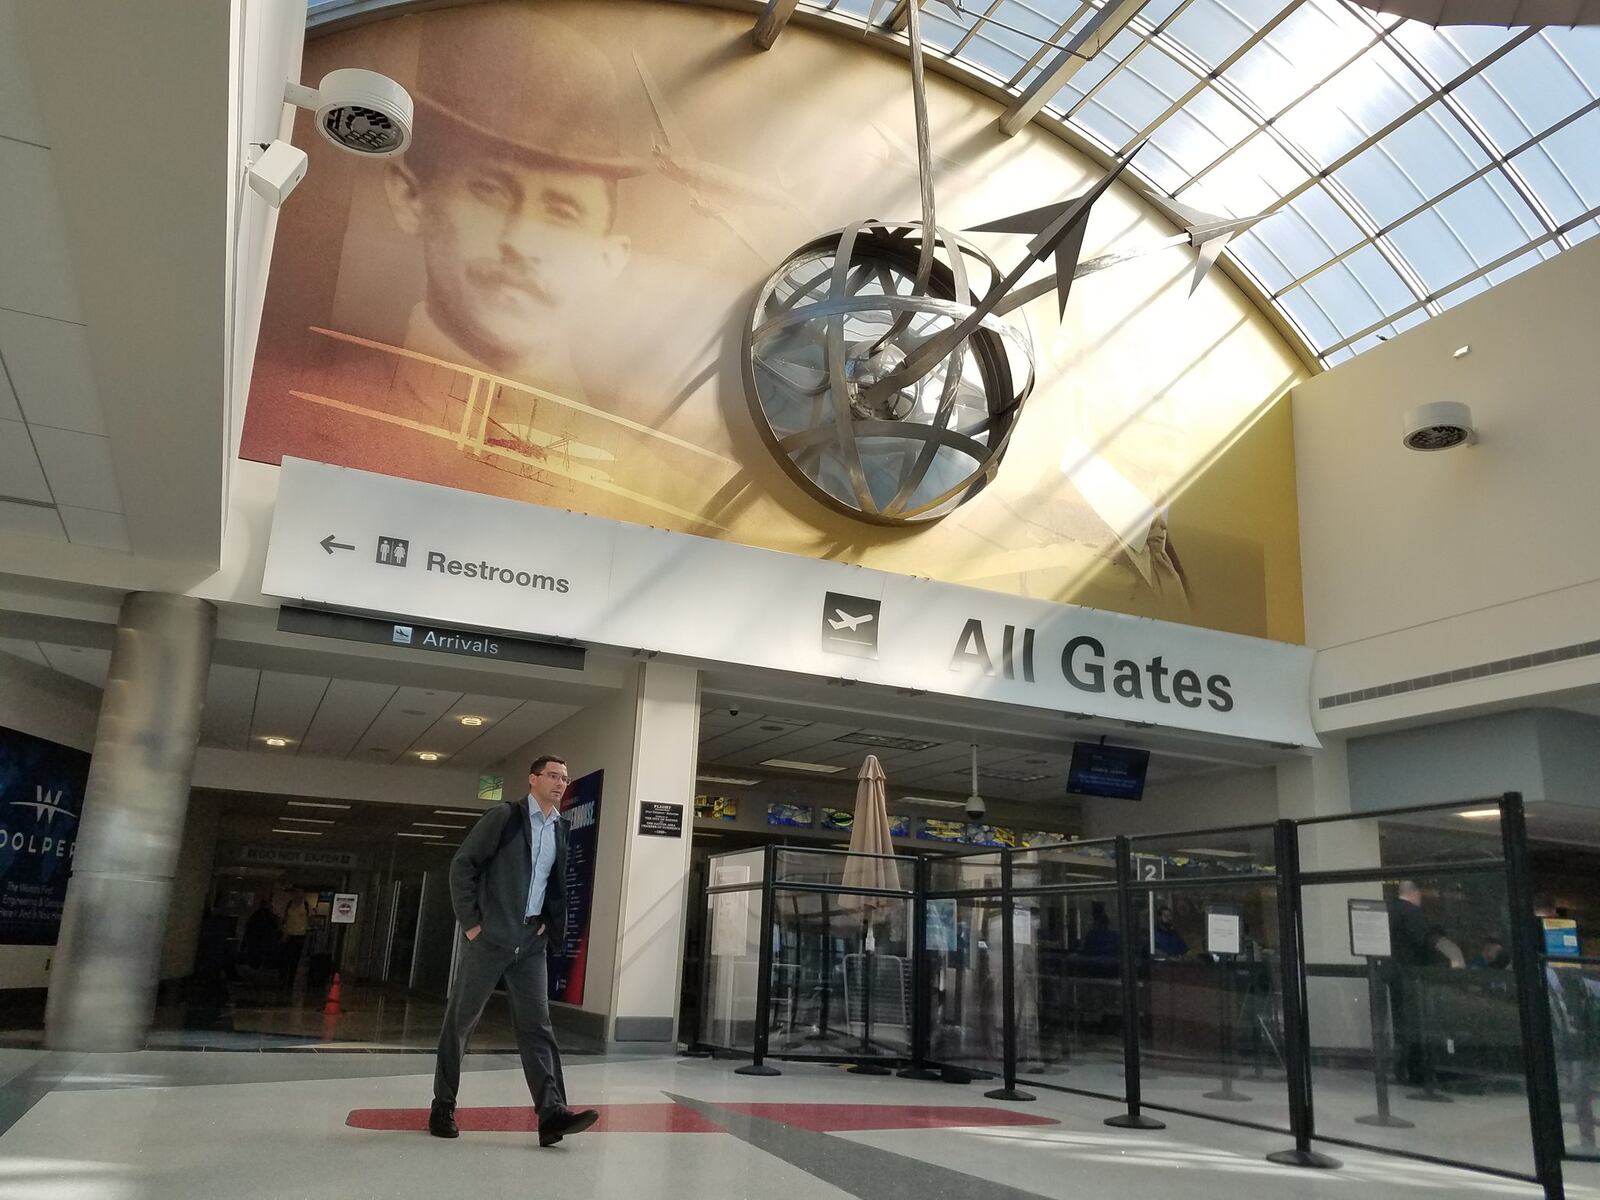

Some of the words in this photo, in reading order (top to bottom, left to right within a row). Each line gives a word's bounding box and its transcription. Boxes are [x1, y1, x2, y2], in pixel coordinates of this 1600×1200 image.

[426, 551, 570, 593] Restrooms
[422, 631, 499, 654] Arrivals
[948, 618, 1035, 683] All
[1061, 635, 1235, 712] Gates
[1145, 864, 1156, 881] 2
